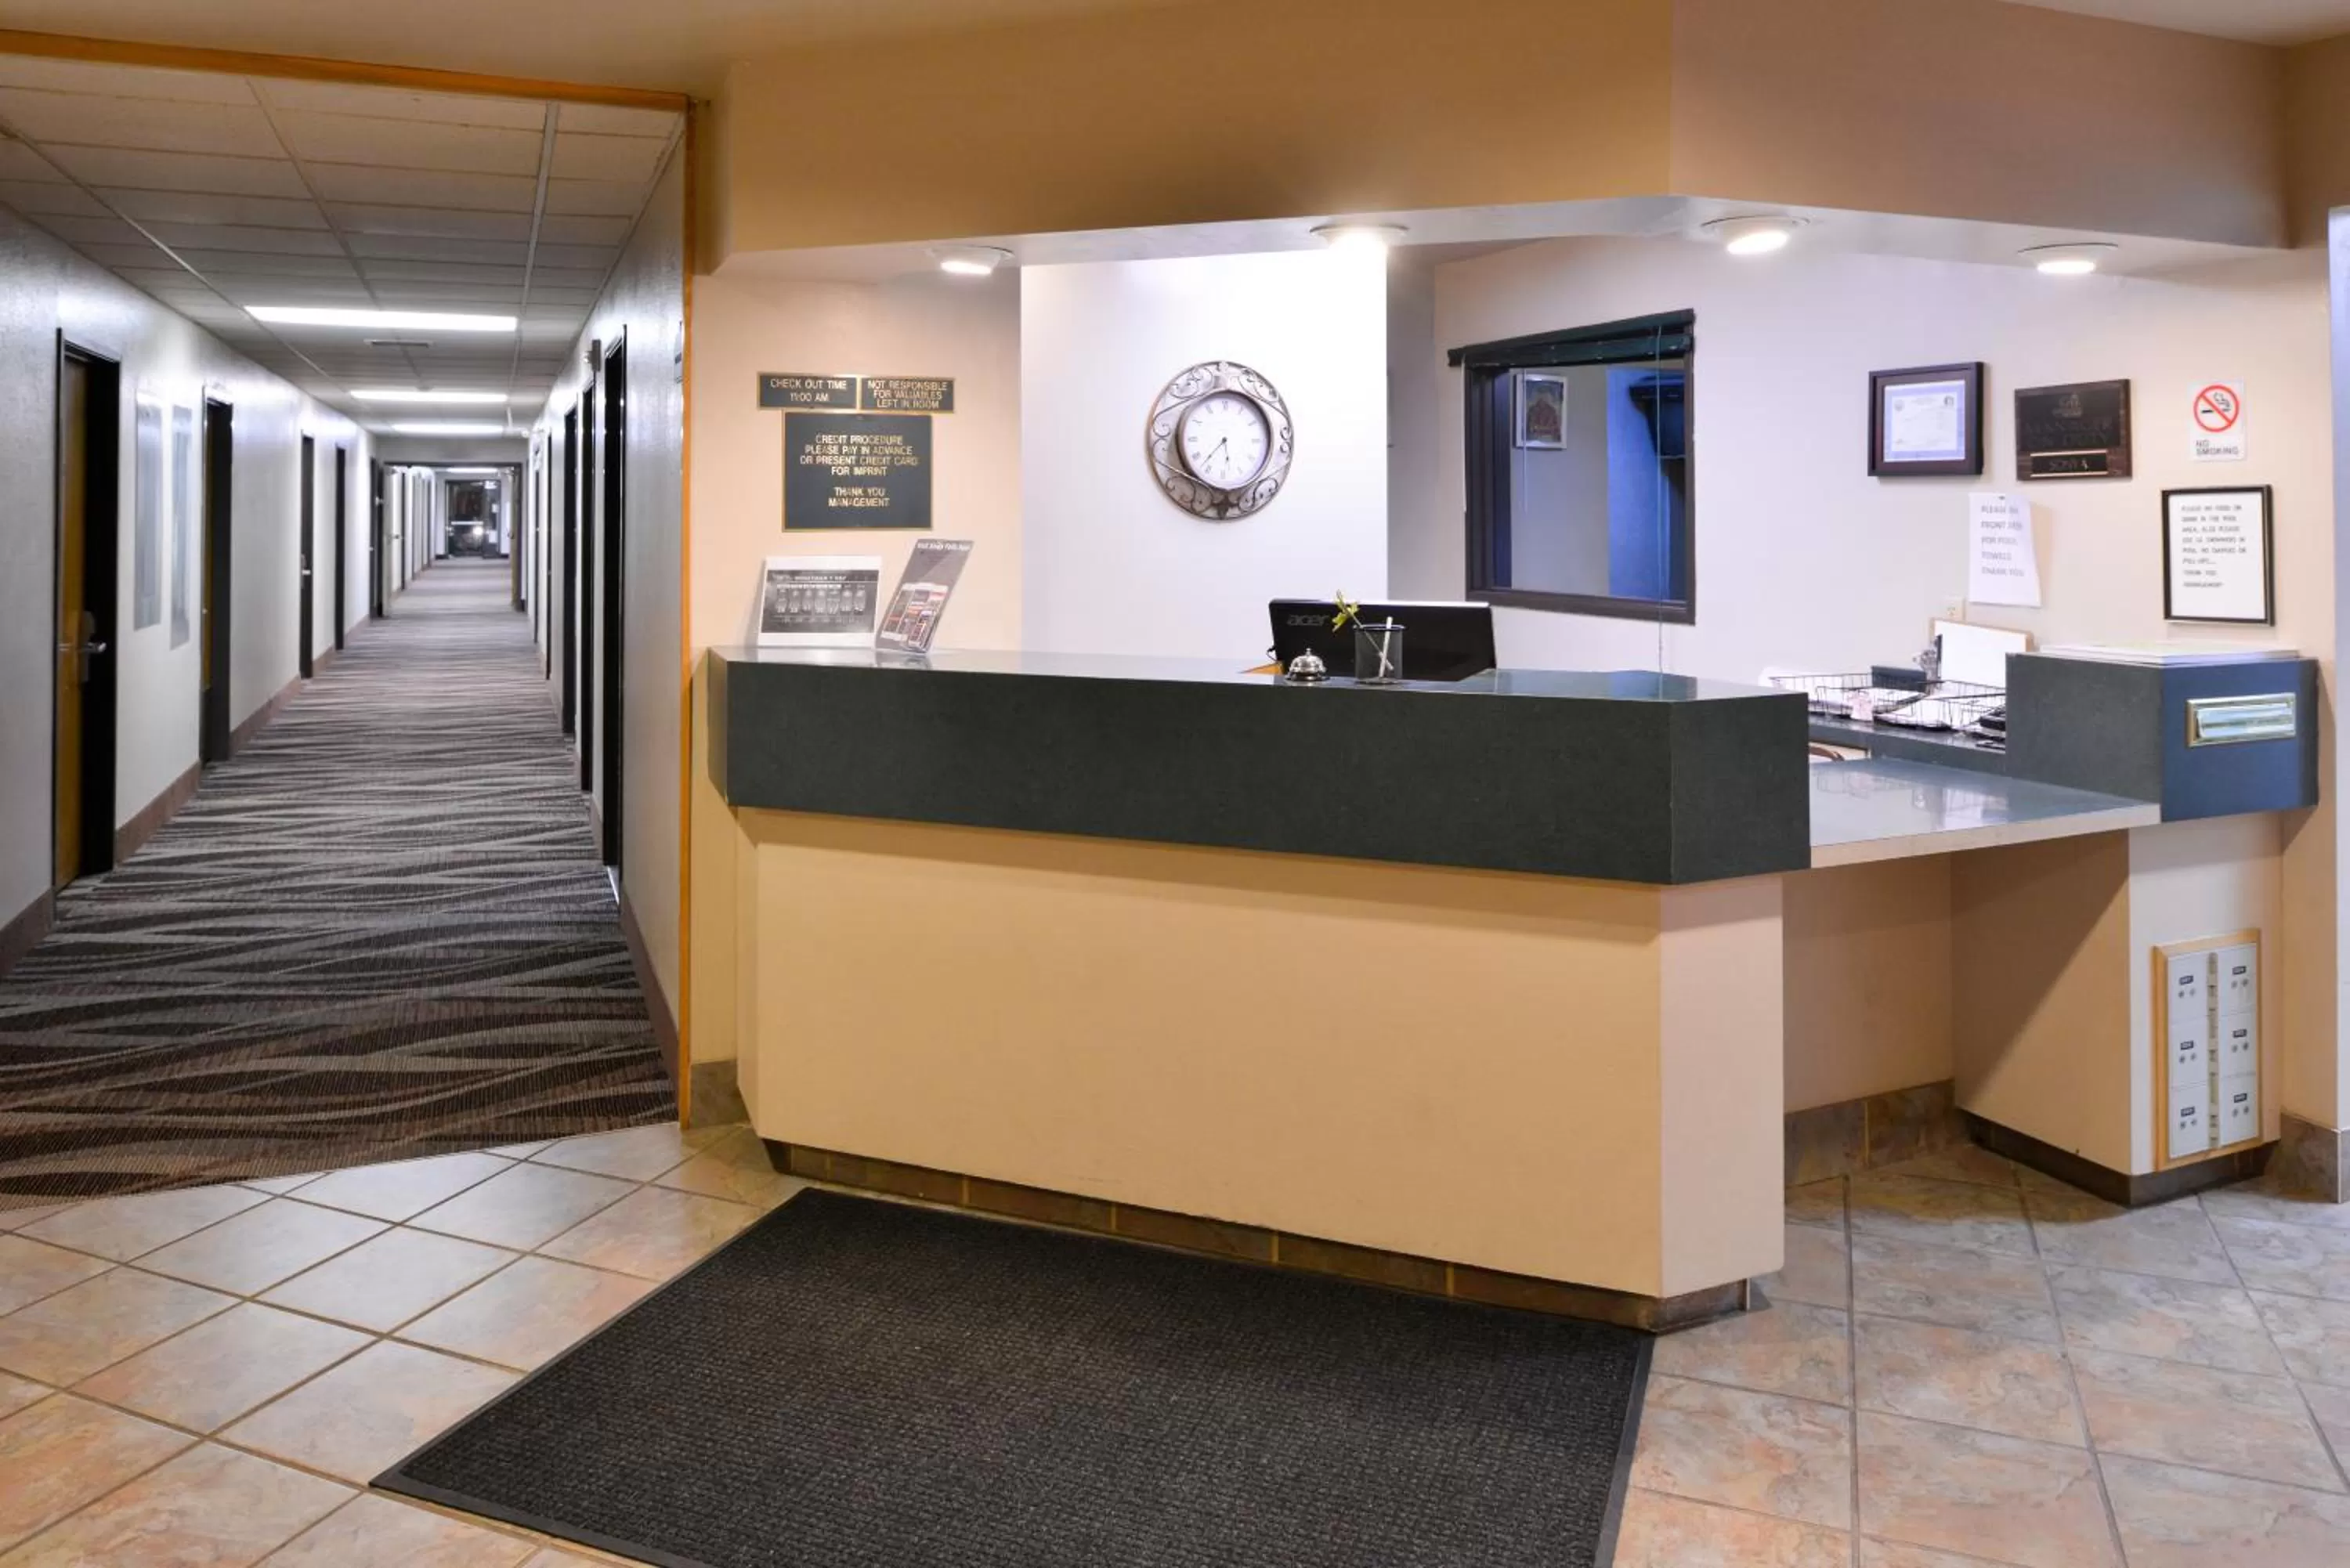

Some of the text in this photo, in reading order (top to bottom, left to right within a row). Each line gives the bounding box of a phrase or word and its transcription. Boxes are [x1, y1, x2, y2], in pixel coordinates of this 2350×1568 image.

[770, 378, 847, 389] CHECK OUT TIME
[868, 380, 947, 391] NOT RESPONSIBLE
[815, 392, 829, 402] AM
[873, 390, 891, 399] FOR
[877, 399, 898, 408] LEFT
[815, 435, 903, 445] CREDIT PROCEDURE
[2196, 439, 2210, 448] NO
[804, 445, 913, 455] PLEASE PAY IN ADVANCE
[2196, 446, 2239, 456] SMOKING
[800, 456, 919, 466] OR PRESENT CREDIT CARD
[831, 467, 888, 476] FOR IMPRINT
[834, 487, 885, 497] THANK YOU
[828, 497, 891, 508] MANAGEMENT
[1286, 614, 1329, 627] acer
